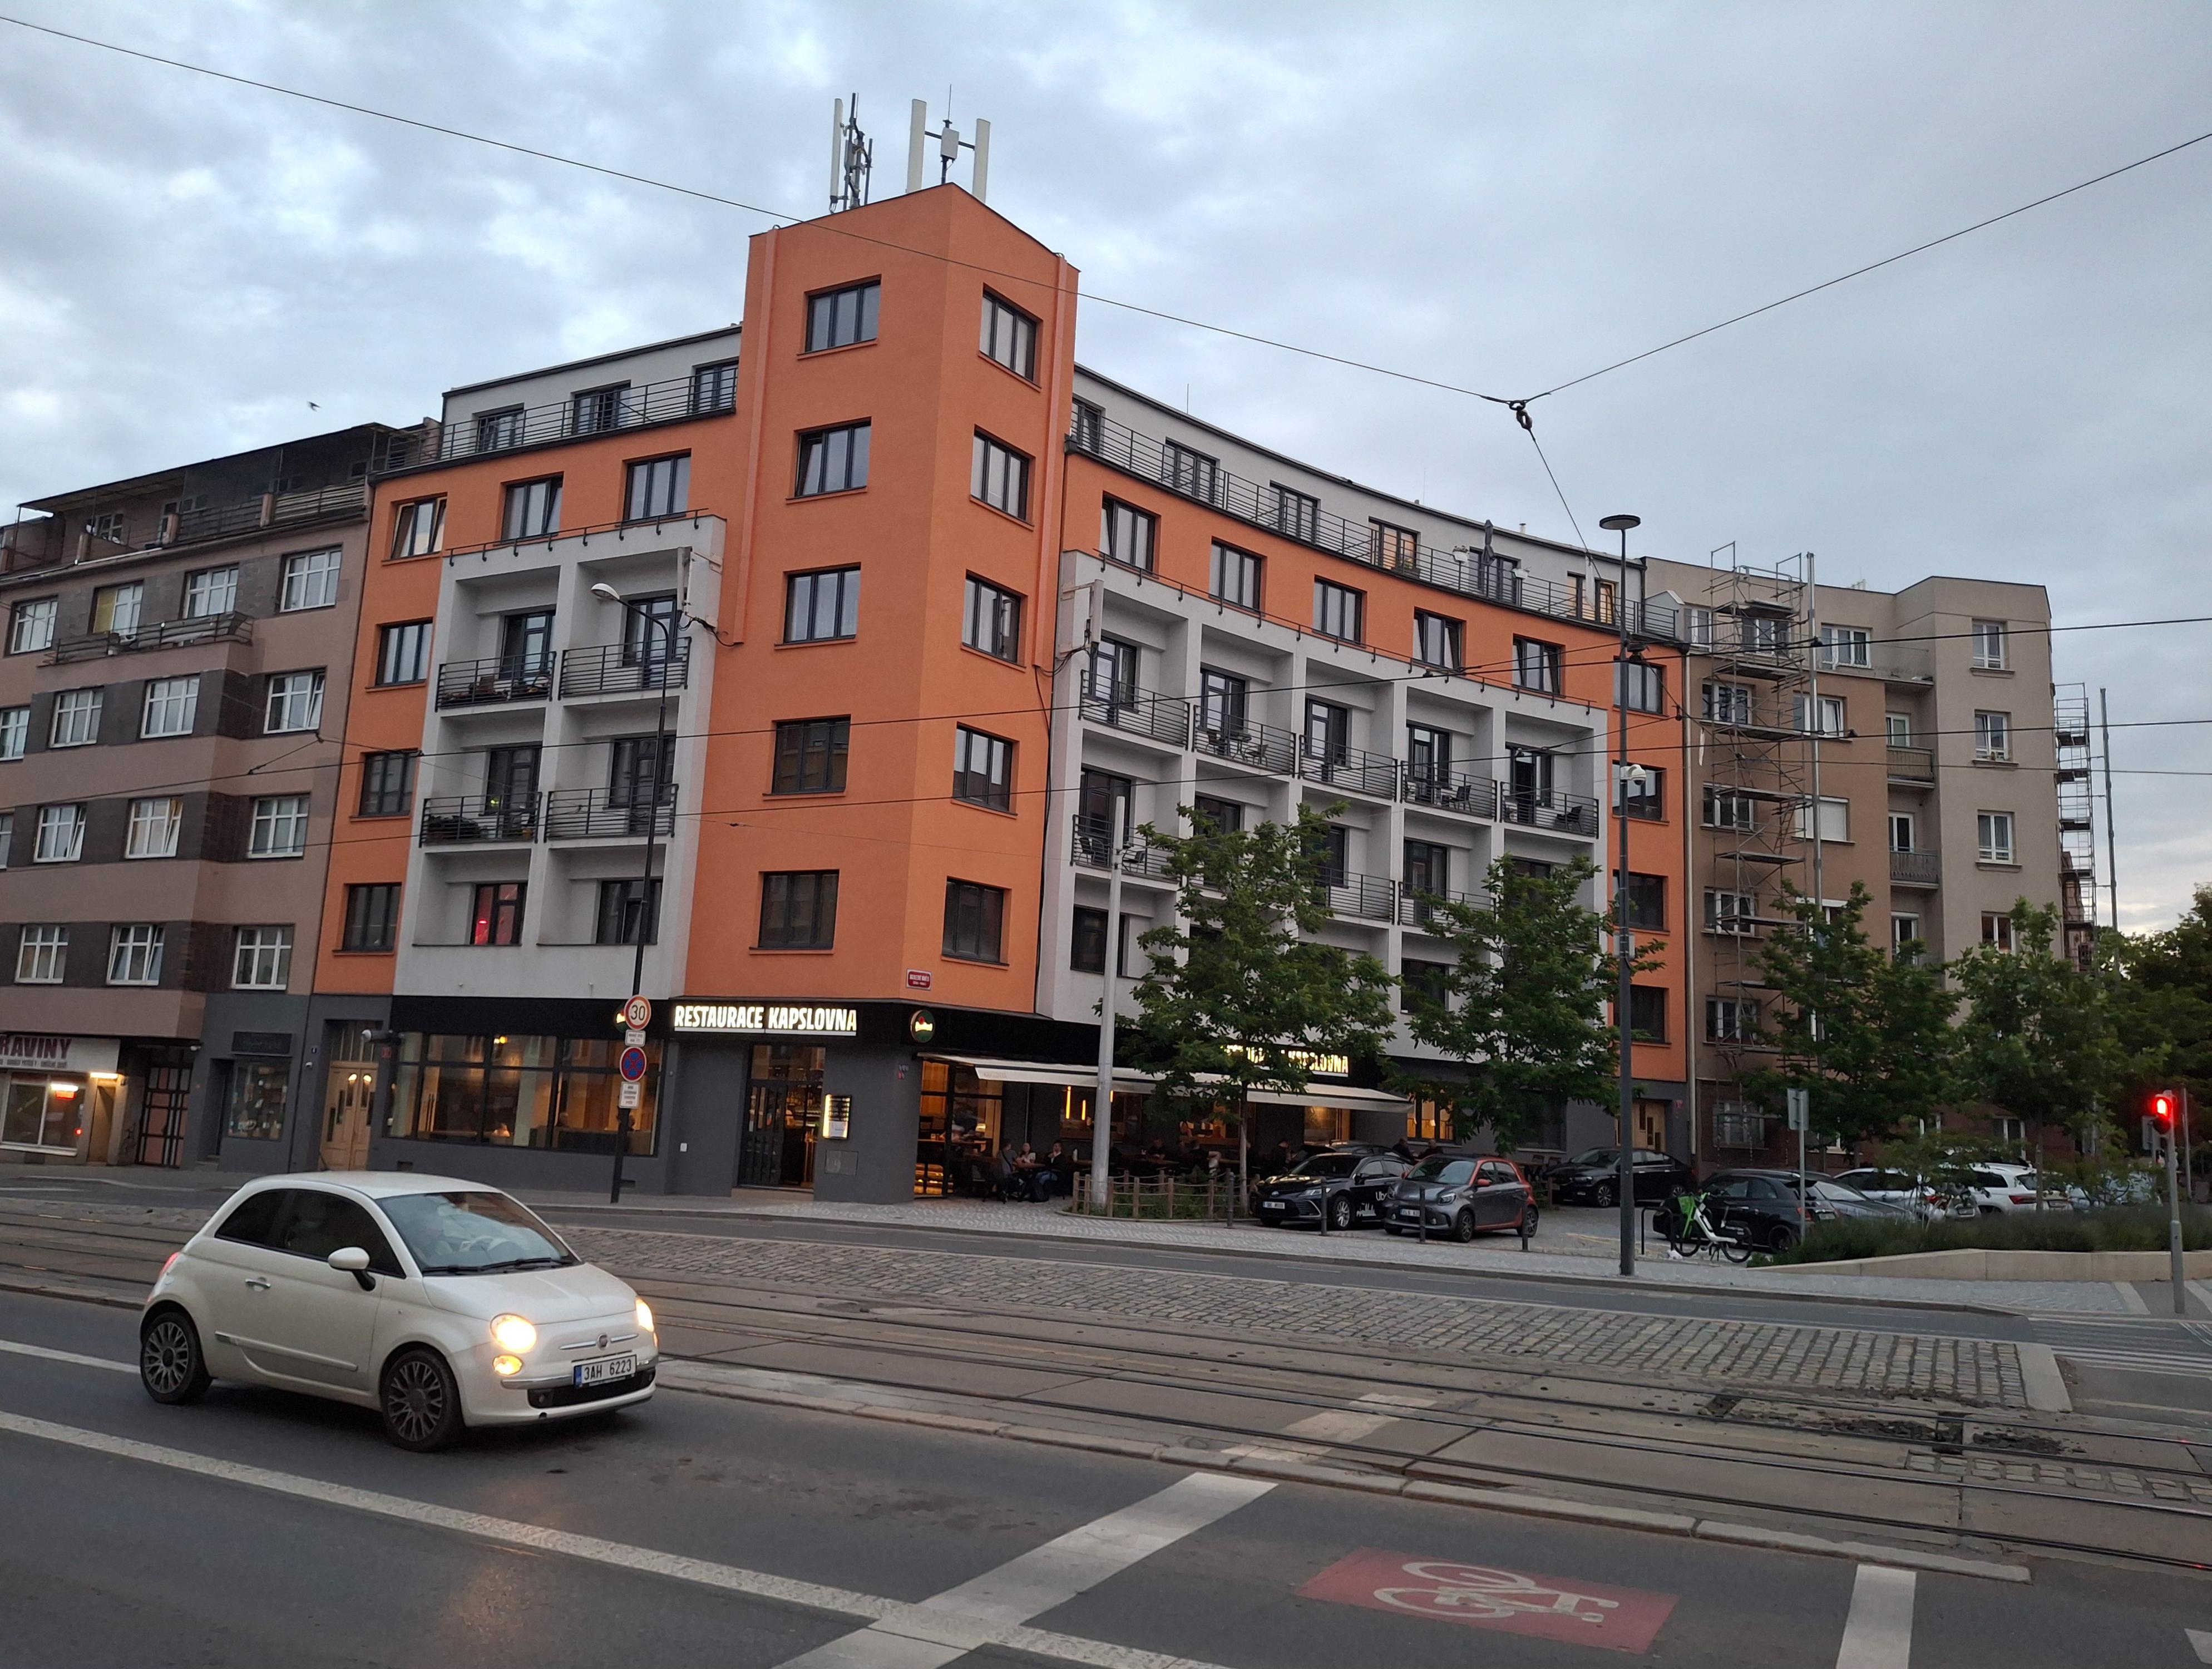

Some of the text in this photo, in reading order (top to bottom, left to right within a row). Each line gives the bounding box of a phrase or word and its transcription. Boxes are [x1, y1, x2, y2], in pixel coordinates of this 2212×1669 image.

[631, 1005, 645, 1021] 30
[674, 1005, 857, 1031] RESTAURACE KAPSLOVNA
[584, 1359, 632, 1380] 3AH 6223
